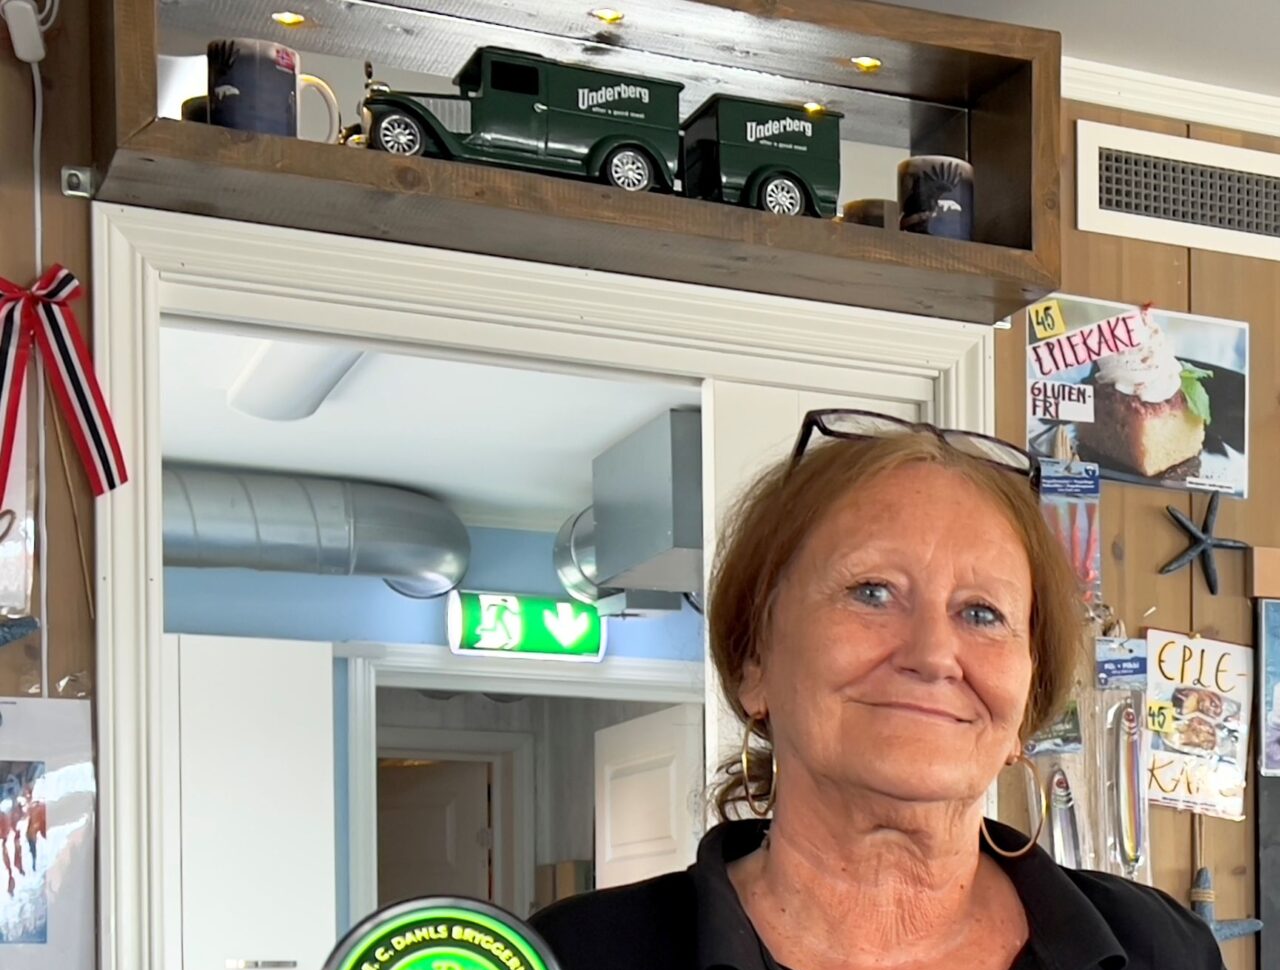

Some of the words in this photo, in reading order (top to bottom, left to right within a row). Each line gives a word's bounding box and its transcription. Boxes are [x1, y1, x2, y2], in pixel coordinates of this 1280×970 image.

[578, 83, 649, 109] Underberg
[746, 116, 812, 142] Underberg
[1035, 306, 1055, 332] 45
[1031, 382, 1092, 405] GLUTEN-
[391, 925, 448, 950] DAHLS
